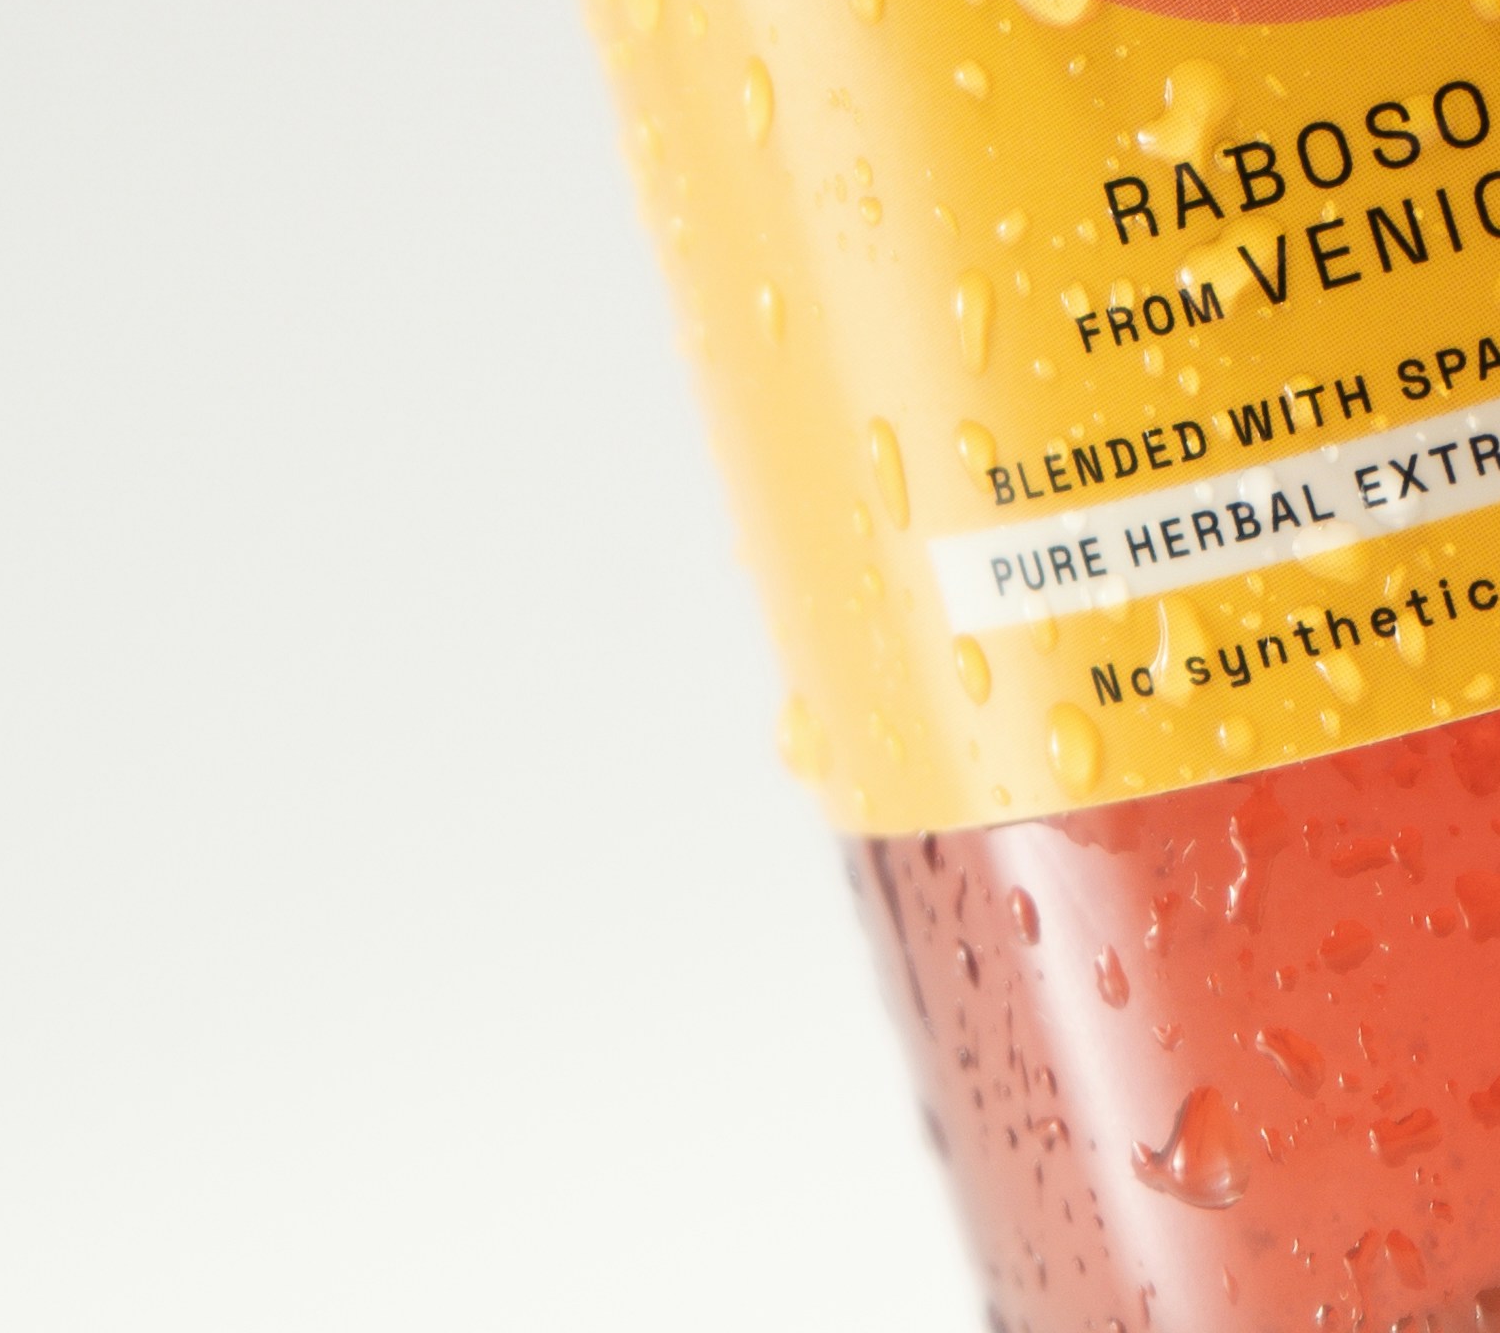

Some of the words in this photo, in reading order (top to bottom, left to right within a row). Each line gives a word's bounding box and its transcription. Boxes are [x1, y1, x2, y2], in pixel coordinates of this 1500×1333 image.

[1102, 79, 1492, 247] RABOSO
[1074, 281, 1226, 355] FROM
[985, 419, 1210, 508] BLENDED
[1226, 373, 1375, 447] WITH
[989, 536, 1109, 597] PURE
[1124, 483, 1337, 569] HERBAL
[1089, 661, 1156, 708] No
[1184, 577, 1500, 689] synthetic
